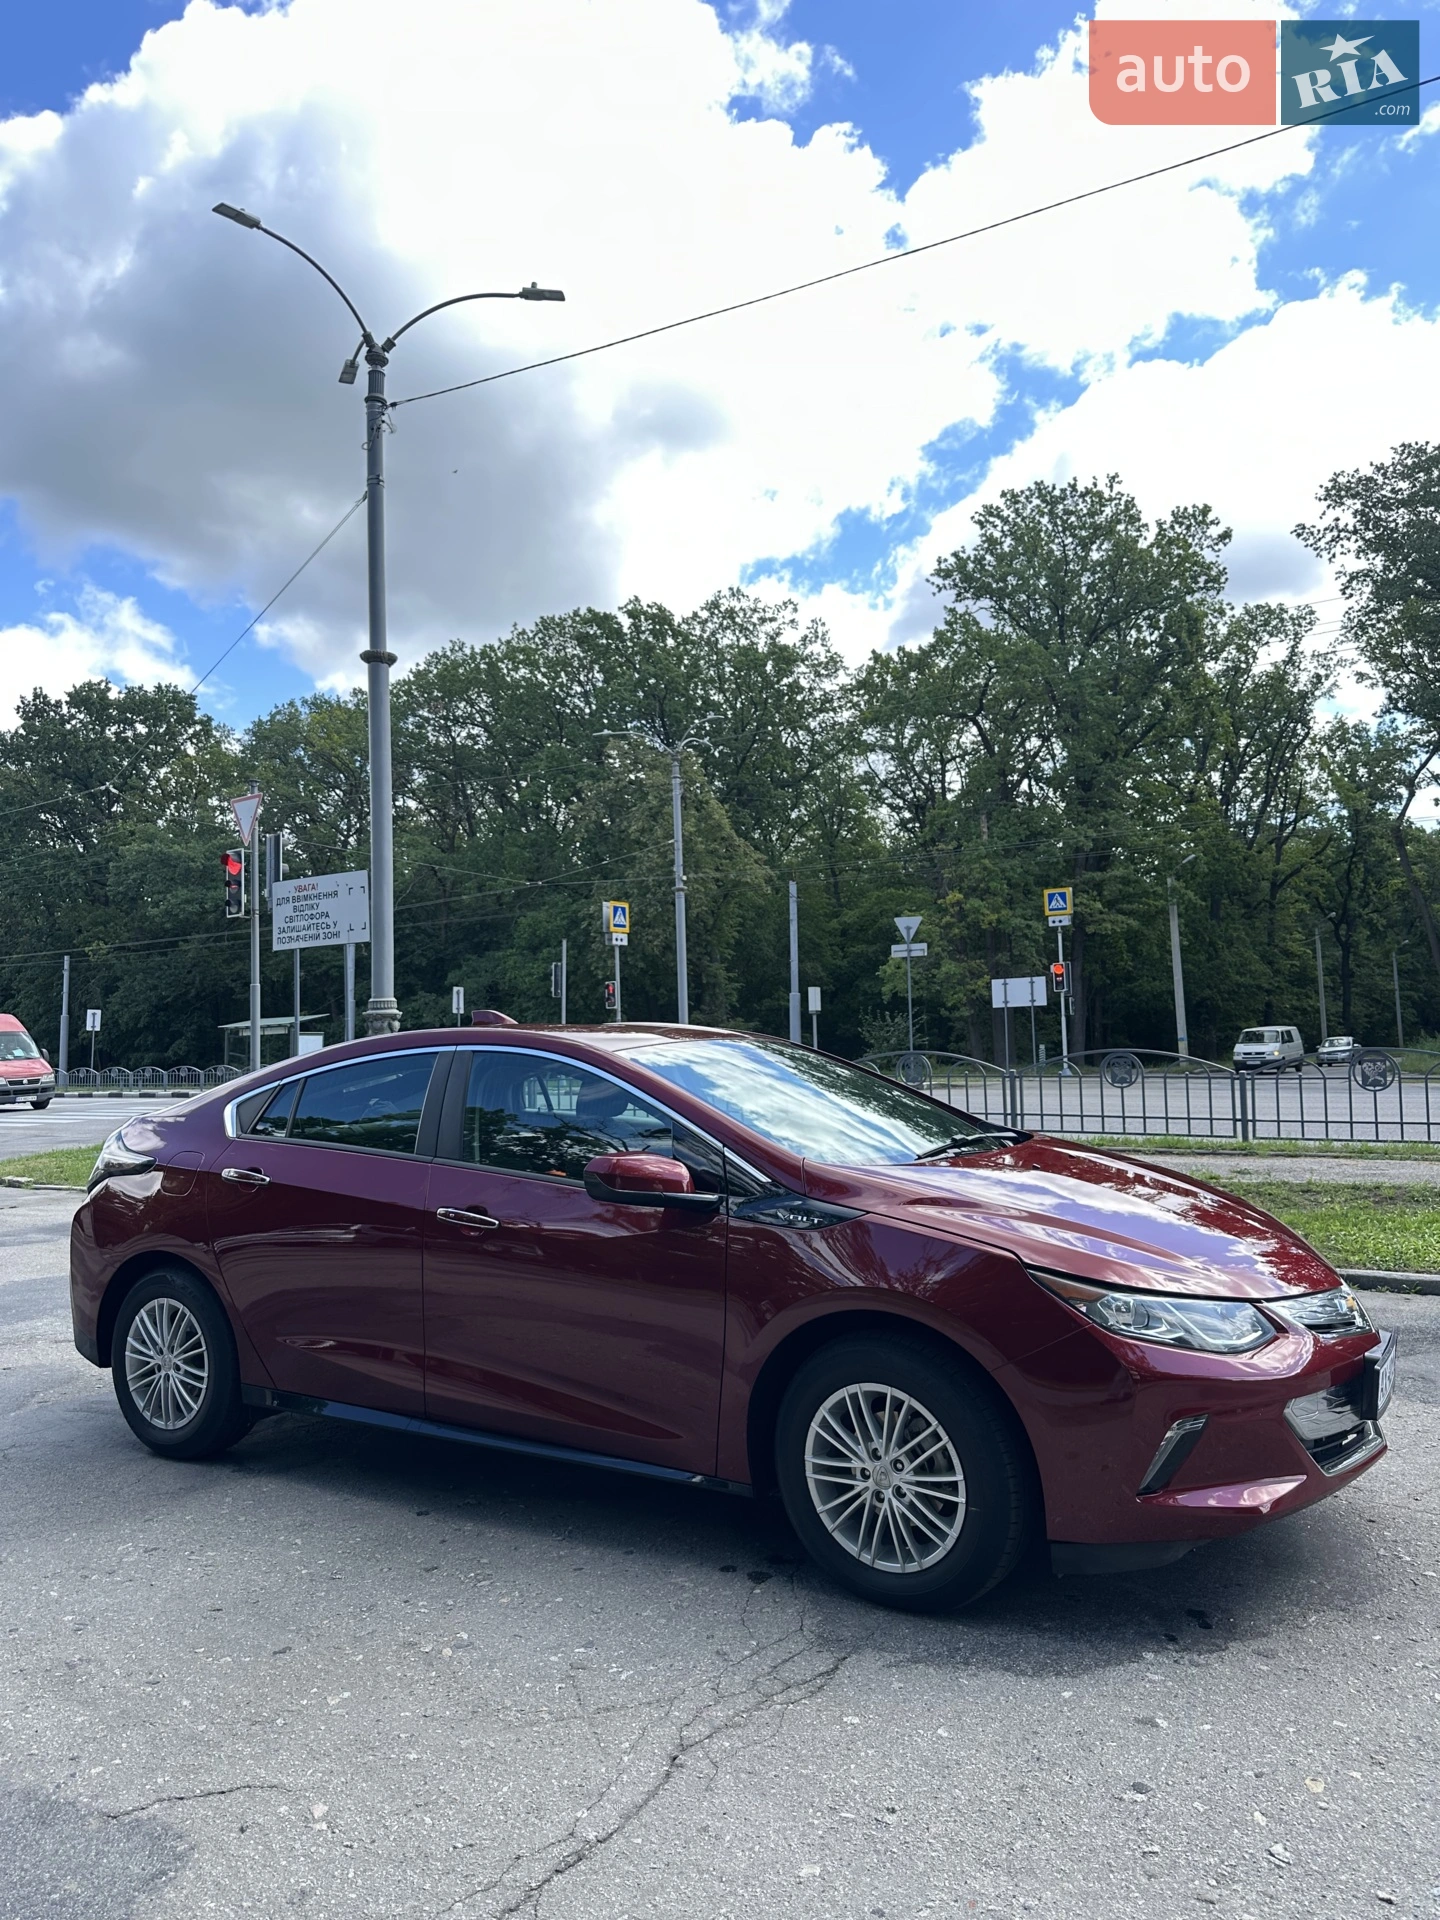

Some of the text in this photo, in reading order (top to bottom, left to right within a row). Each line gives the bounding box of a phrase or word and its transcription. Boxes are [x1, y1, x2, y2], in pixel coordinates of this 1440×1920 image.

[294, 883, 319, 893] УВАГА!
[276, 890, 338, 906] ДЛЯ ВВІМКНЕННЯ
[293, 902, 320, 913] ВІДЛІКУ
[284, 911, 330, 924] СВІТЛОФОРА
[277, 920, 338, 935] ЗАЛИШАЙТЕСЬ У
[276, 931, 320, 945] ПОЗНАЧЕНІЙ
[776, 1209, 823, 1224] VOLT
